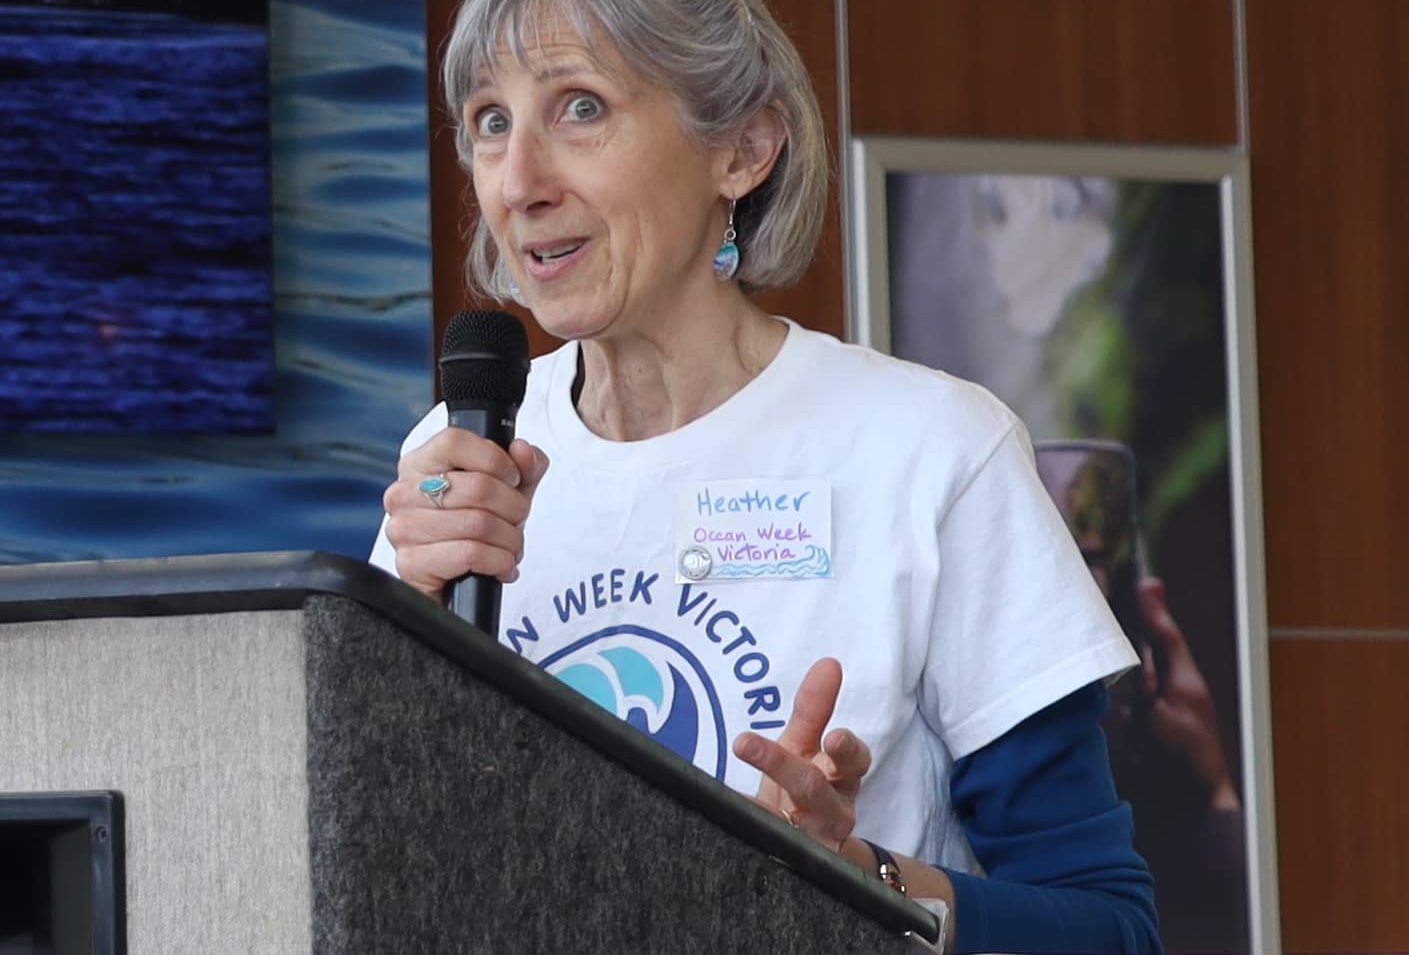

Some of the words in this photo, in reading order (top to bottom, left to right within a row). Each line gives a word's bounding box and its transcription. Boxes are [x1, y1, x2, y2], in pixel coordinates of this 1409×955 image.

[696, 488, 811, 516] Heather
[693, 527, 747, 543] Ocean
[757, 522, 812, 542] Week
[717, 543, 796, 562] Victoria
[506, 616, 539, 653] N
[553, 568, 659, 623] WEEK
[677, 584, 786, 730] VICTORI
